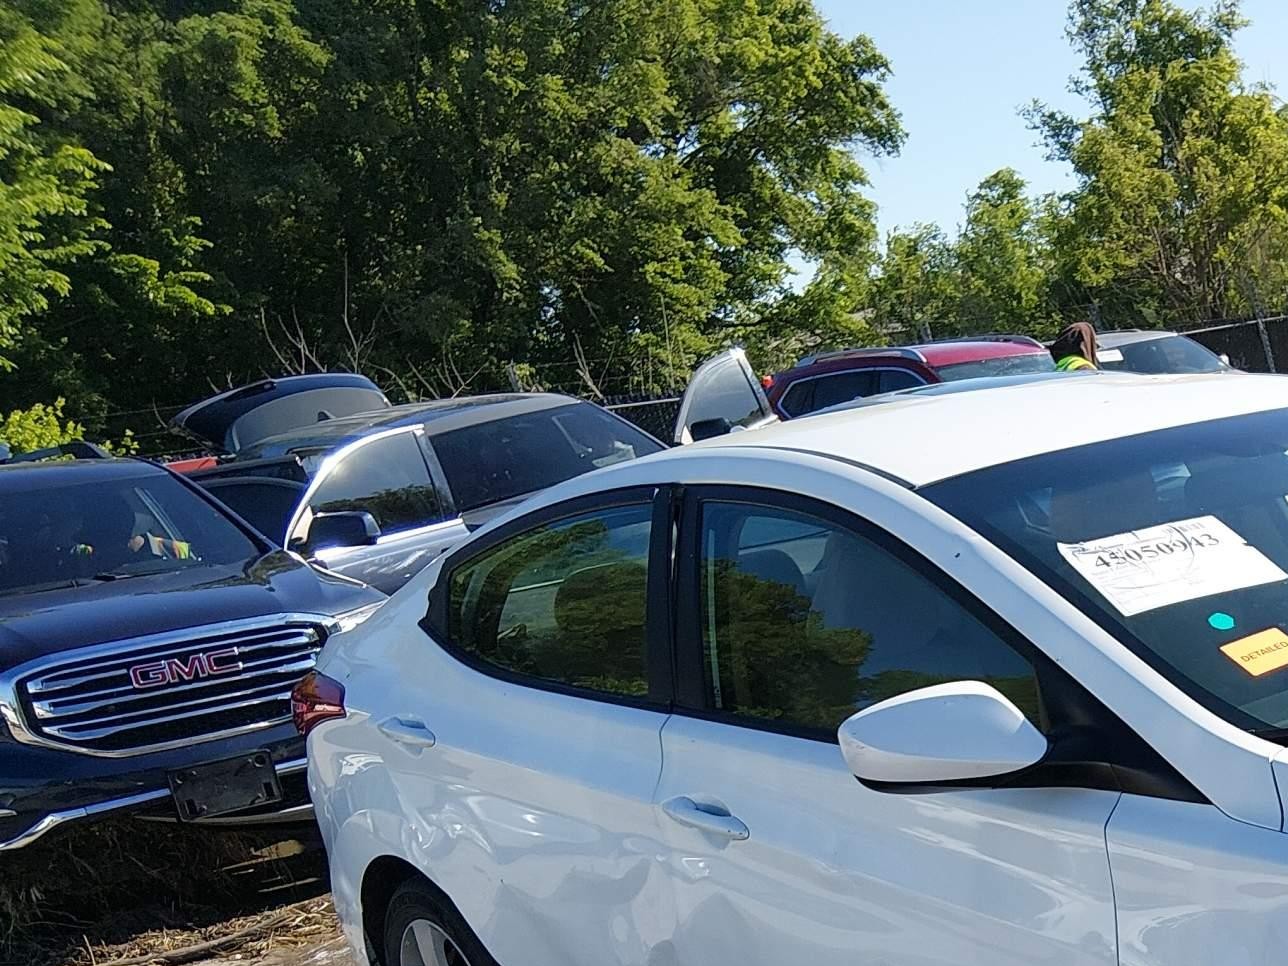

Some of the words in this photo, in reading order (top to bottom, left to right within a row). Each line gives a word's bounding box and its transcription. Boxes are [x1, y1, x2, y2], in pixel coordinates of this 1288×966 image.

[1095, 533, 1220, 568] 45050943
[129, 646, 243, 689] GMC
[1240, 641, 1288, 662] DETAILED
